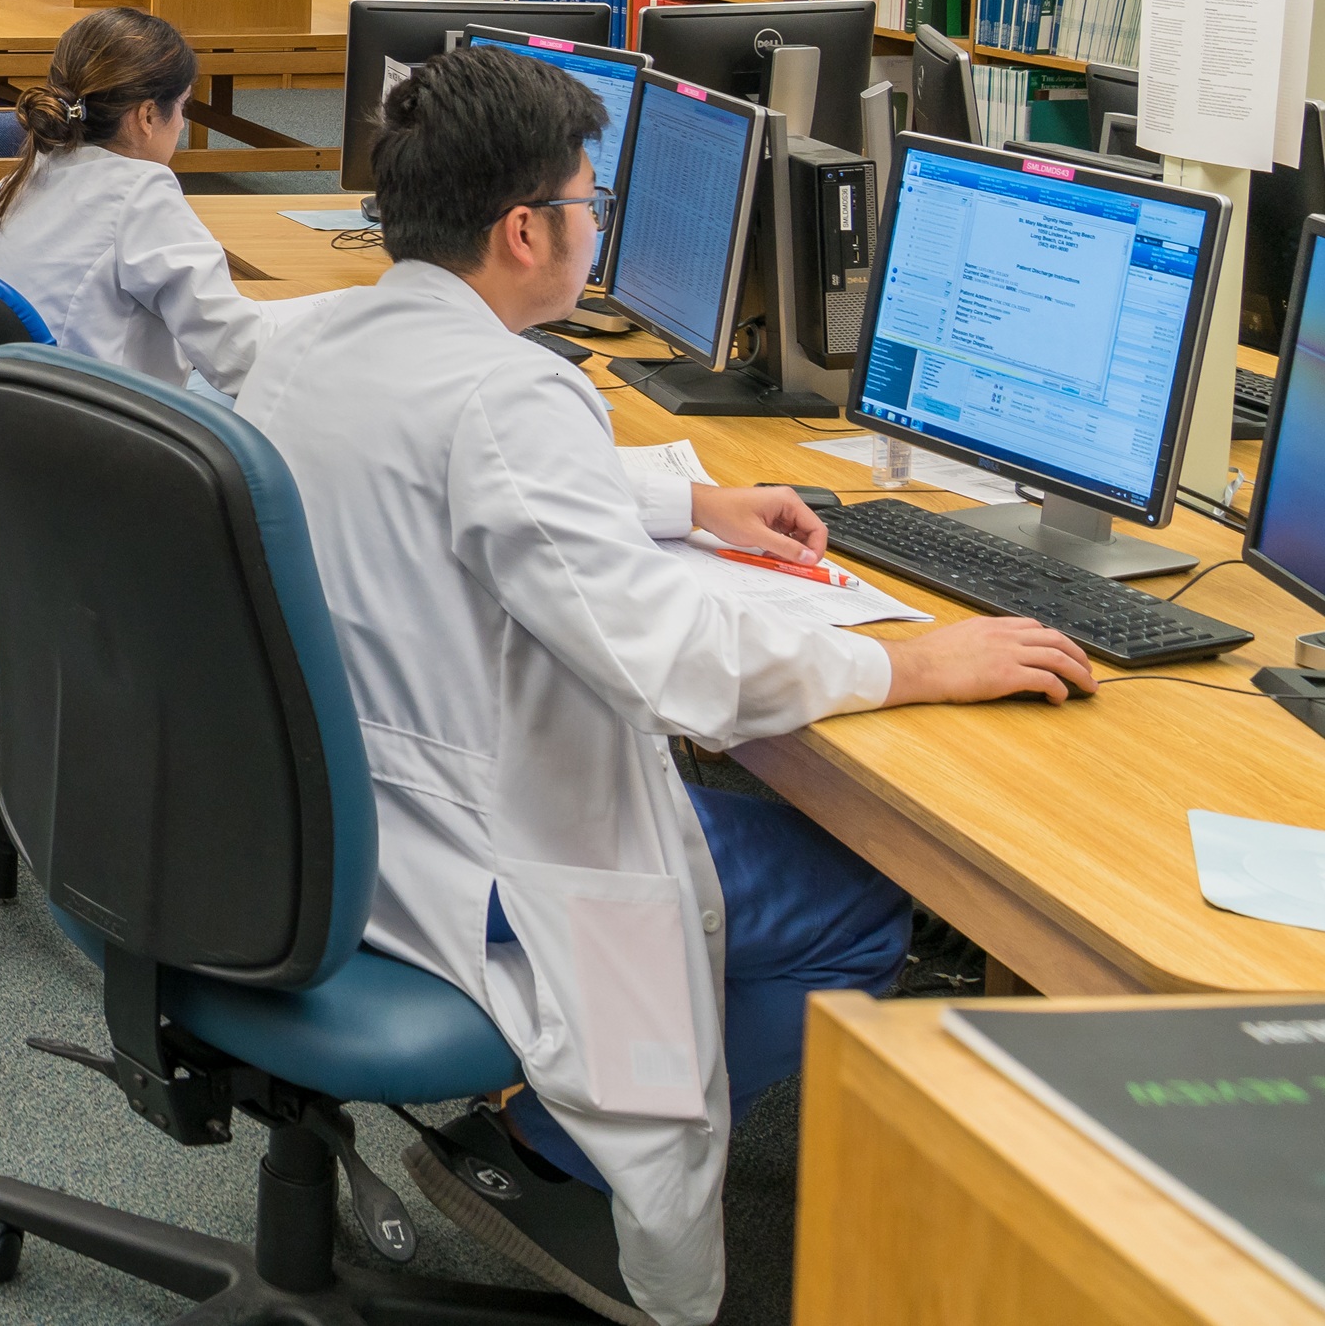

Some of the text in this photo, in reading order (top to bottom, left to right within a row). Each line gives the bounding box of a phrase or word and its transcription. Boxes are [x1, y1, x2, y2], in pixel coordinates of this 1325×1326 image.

[757, 39, 779, 48] DELL
[1026, 161, 1070, 177] SMLDMDS43
[1043, 215, 1073, 227] Dignity Health
[1036, 221, 1053, 230] Medical
[1081, 231, 1096, 240] Beach
[1030, 233, 1041, 242] Long
[847, 276, 868, 284] DELL
[1016, 264, 1080, 284] Patient Discharge Instructions
